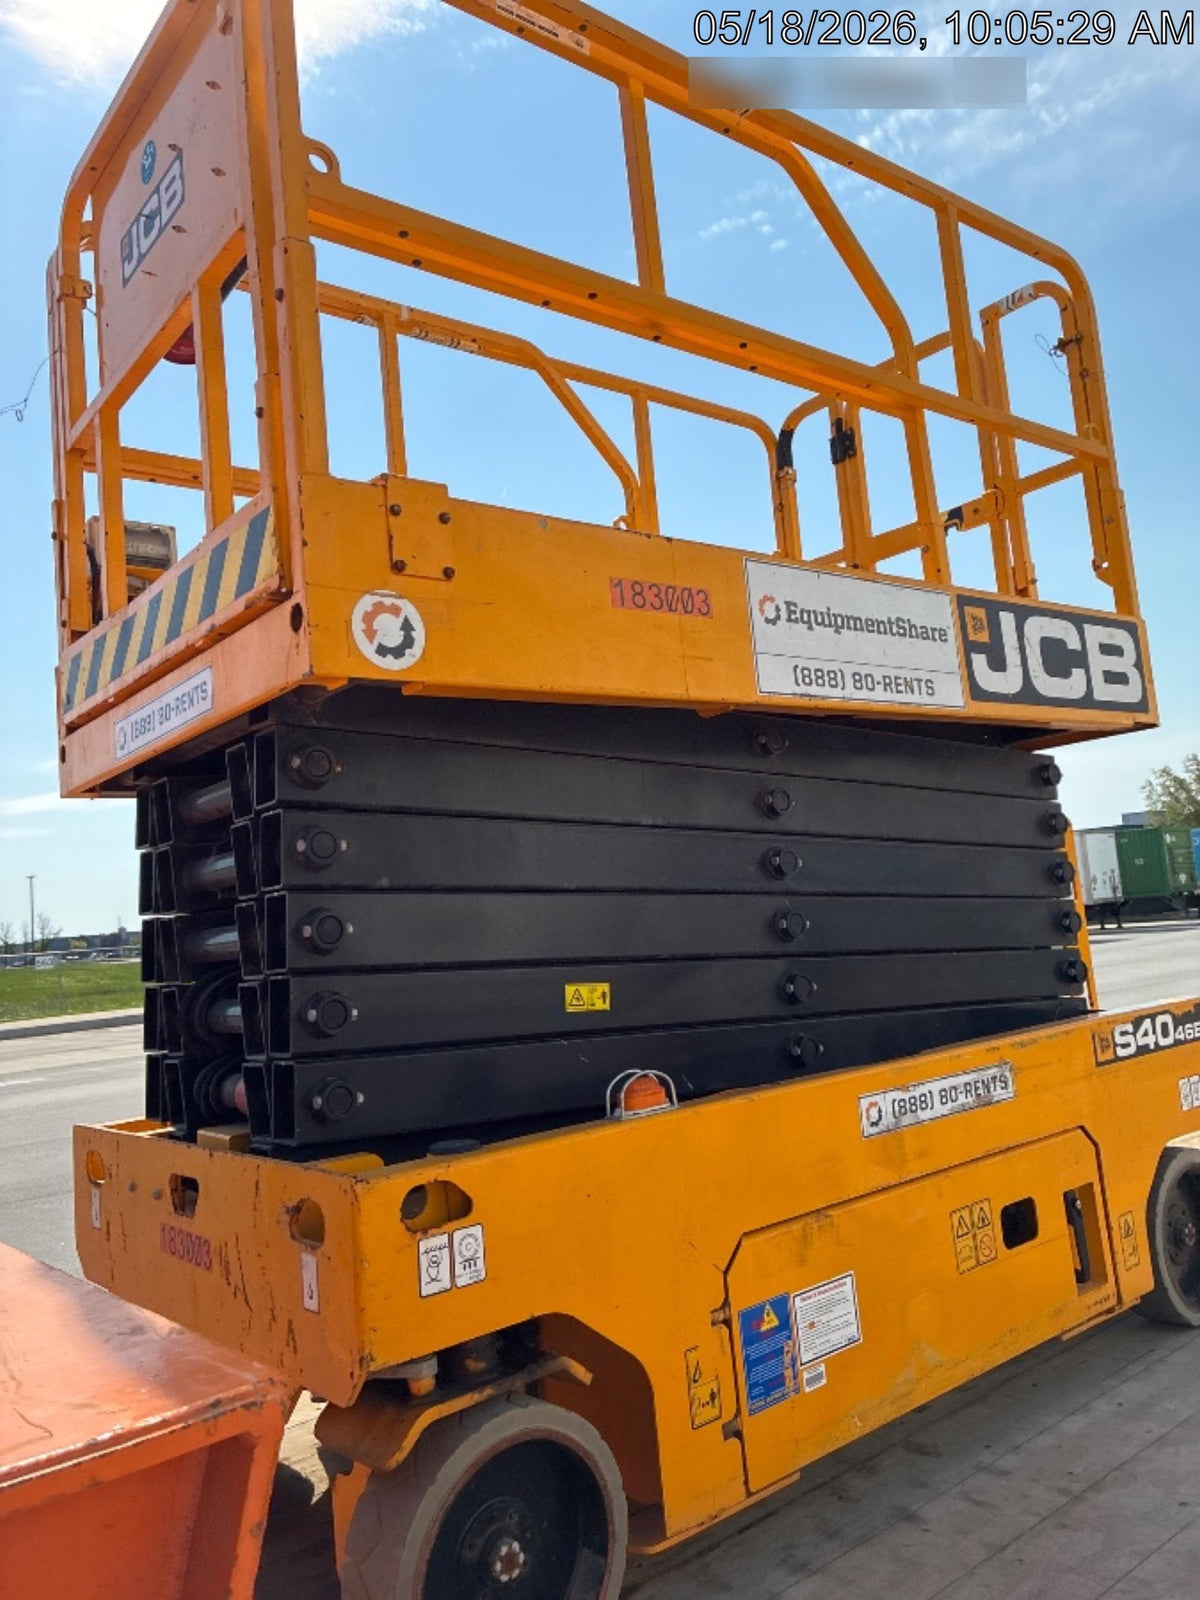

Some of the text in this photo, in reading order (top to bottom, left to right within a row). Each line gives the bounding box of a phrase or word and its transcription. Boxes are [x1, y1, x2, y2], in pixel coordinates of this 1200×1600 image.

[123, 158, 184, 279] JCB
[613, 579, 711, 616] 183003
[783, 600, 949, 644] EquipmentShare
[970, 610, 1143, 703] JCB
[793, 664, 936, 697] (888) 80-RENTS
[892, 1073, 1010, 1120] (888) 80-RENTS
